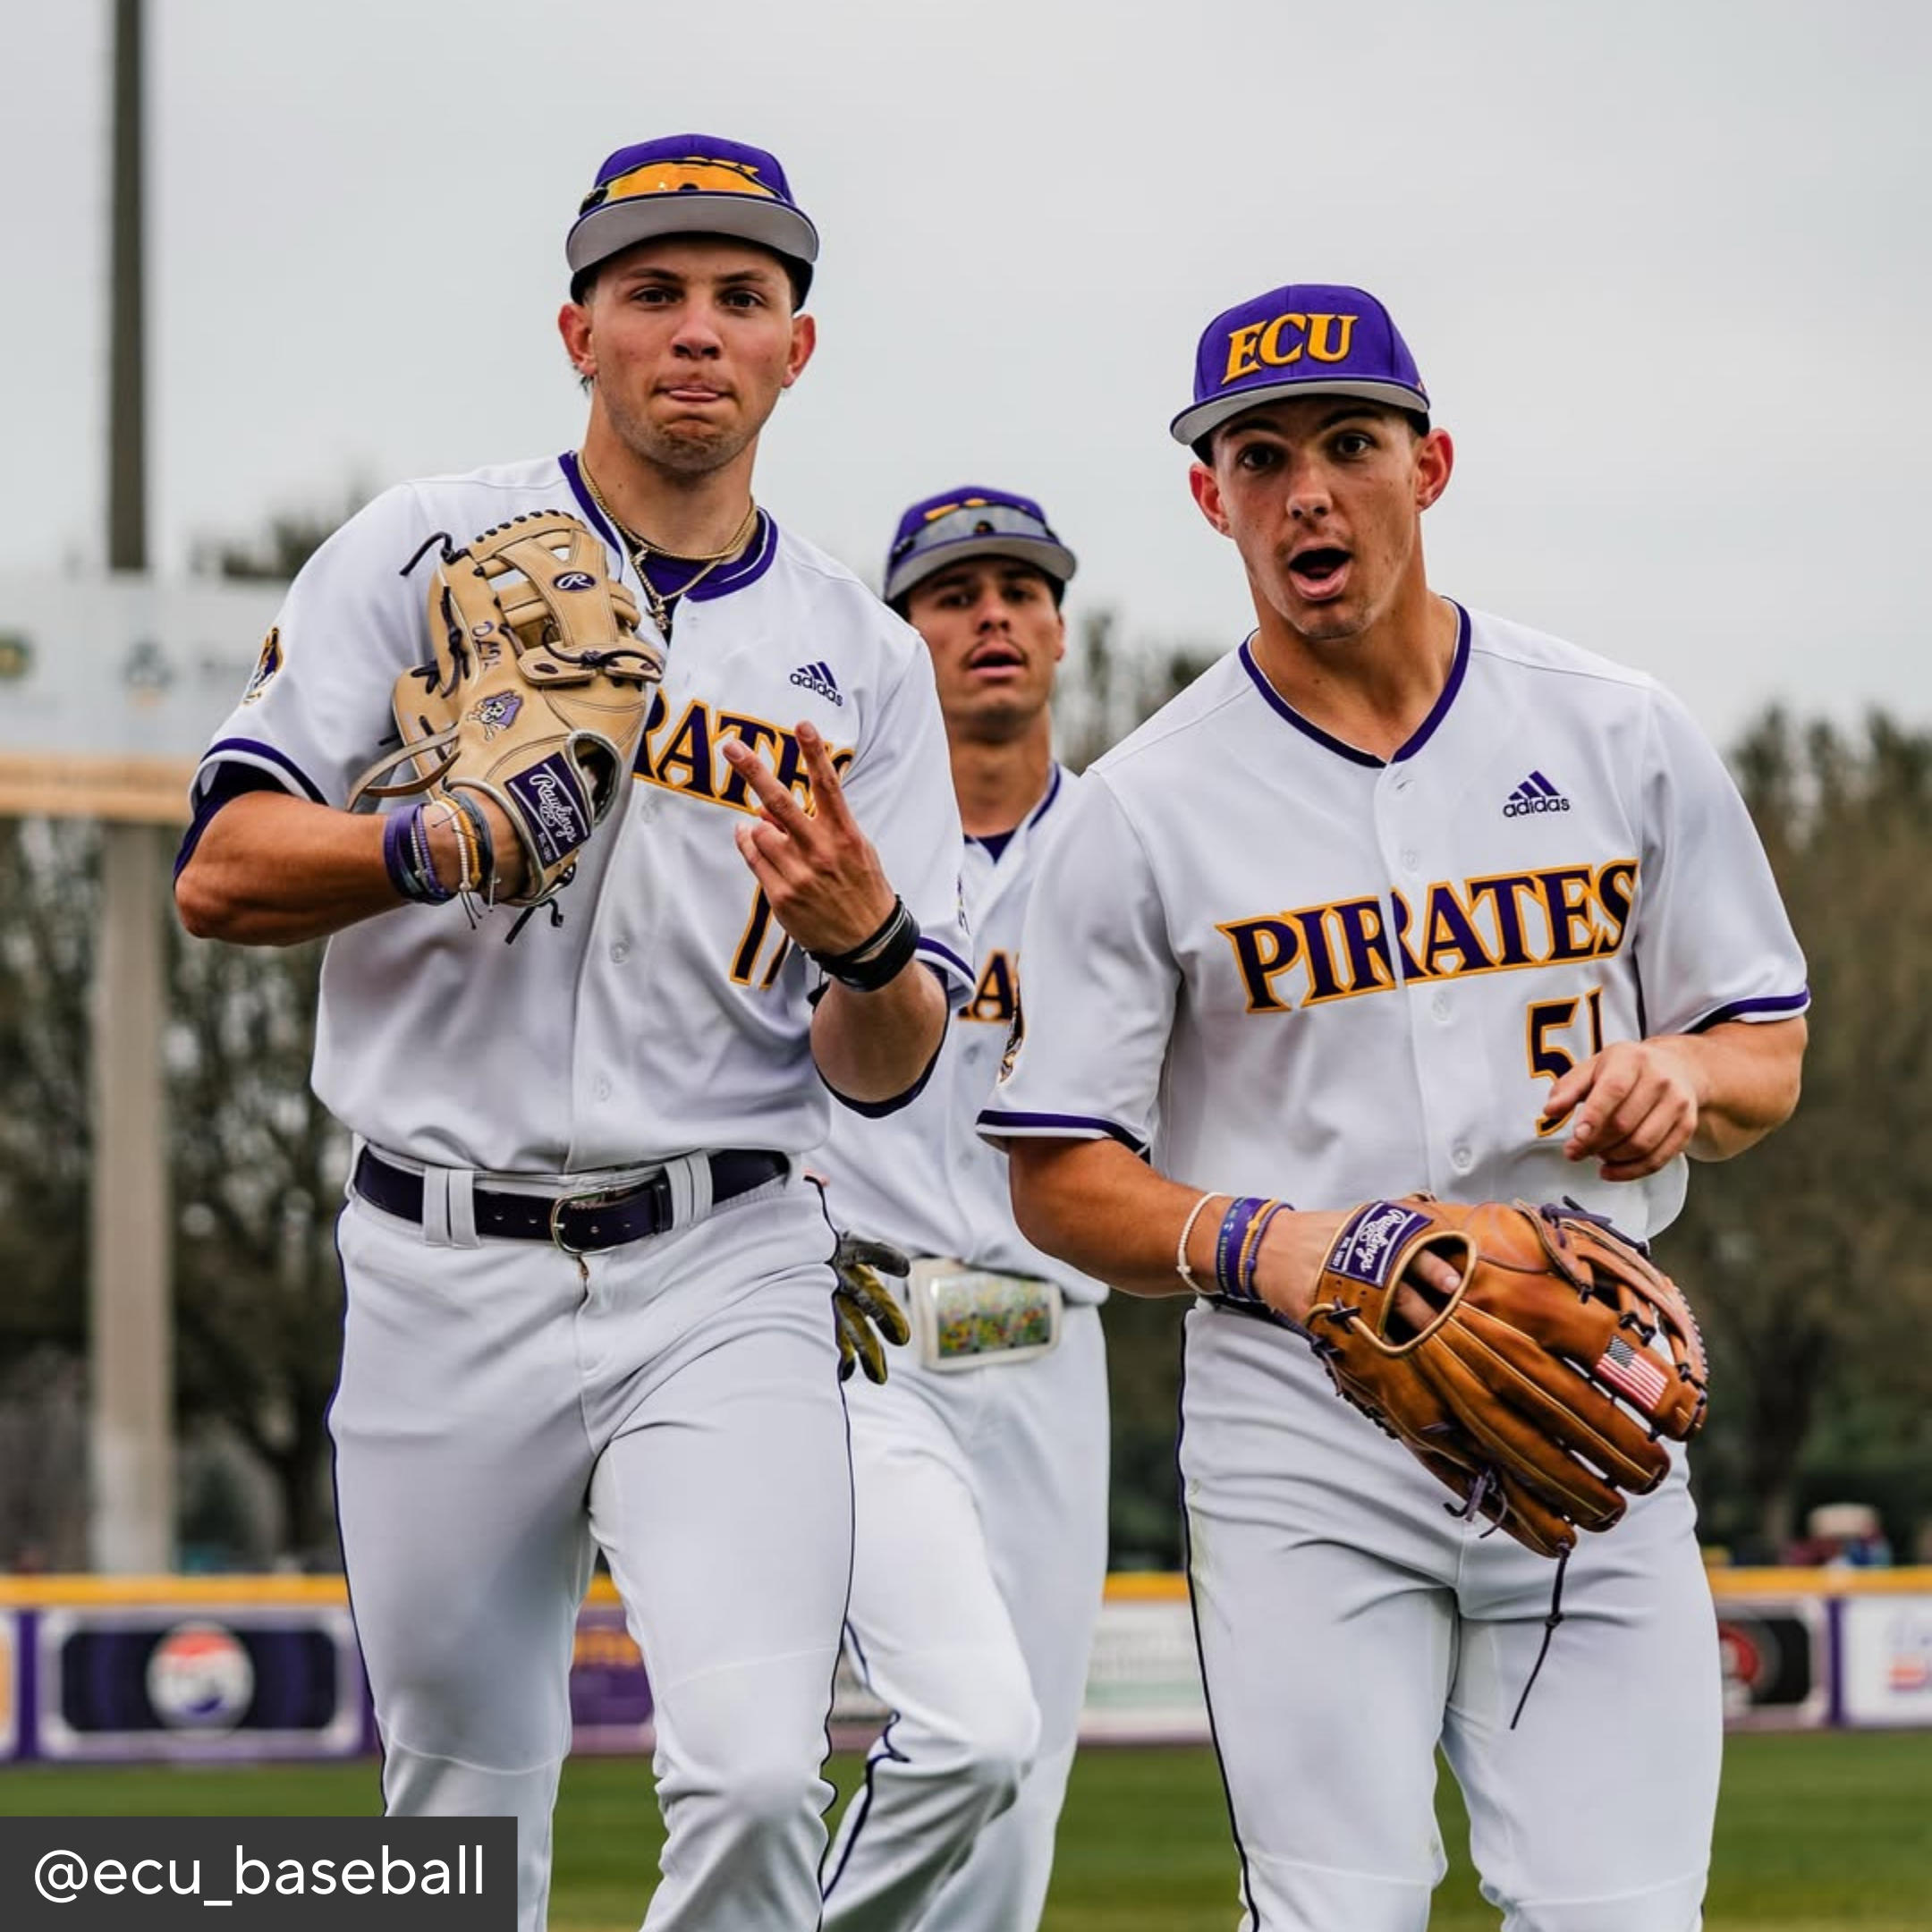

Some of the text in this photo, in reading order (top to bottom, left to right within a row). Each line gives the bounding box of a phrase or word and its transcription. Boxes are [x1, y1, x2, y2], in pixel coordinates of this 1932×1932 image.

[1220, 311, 1360, 386] ECU
[790, 673, 843, 707] adidas
[631, 687, 855, 818] RATE
[530, 773, 577, 843] Rawlings
[1503, 795, 1571, 818] adidas
[1215, 857, 1640, 1014] PIRATES
